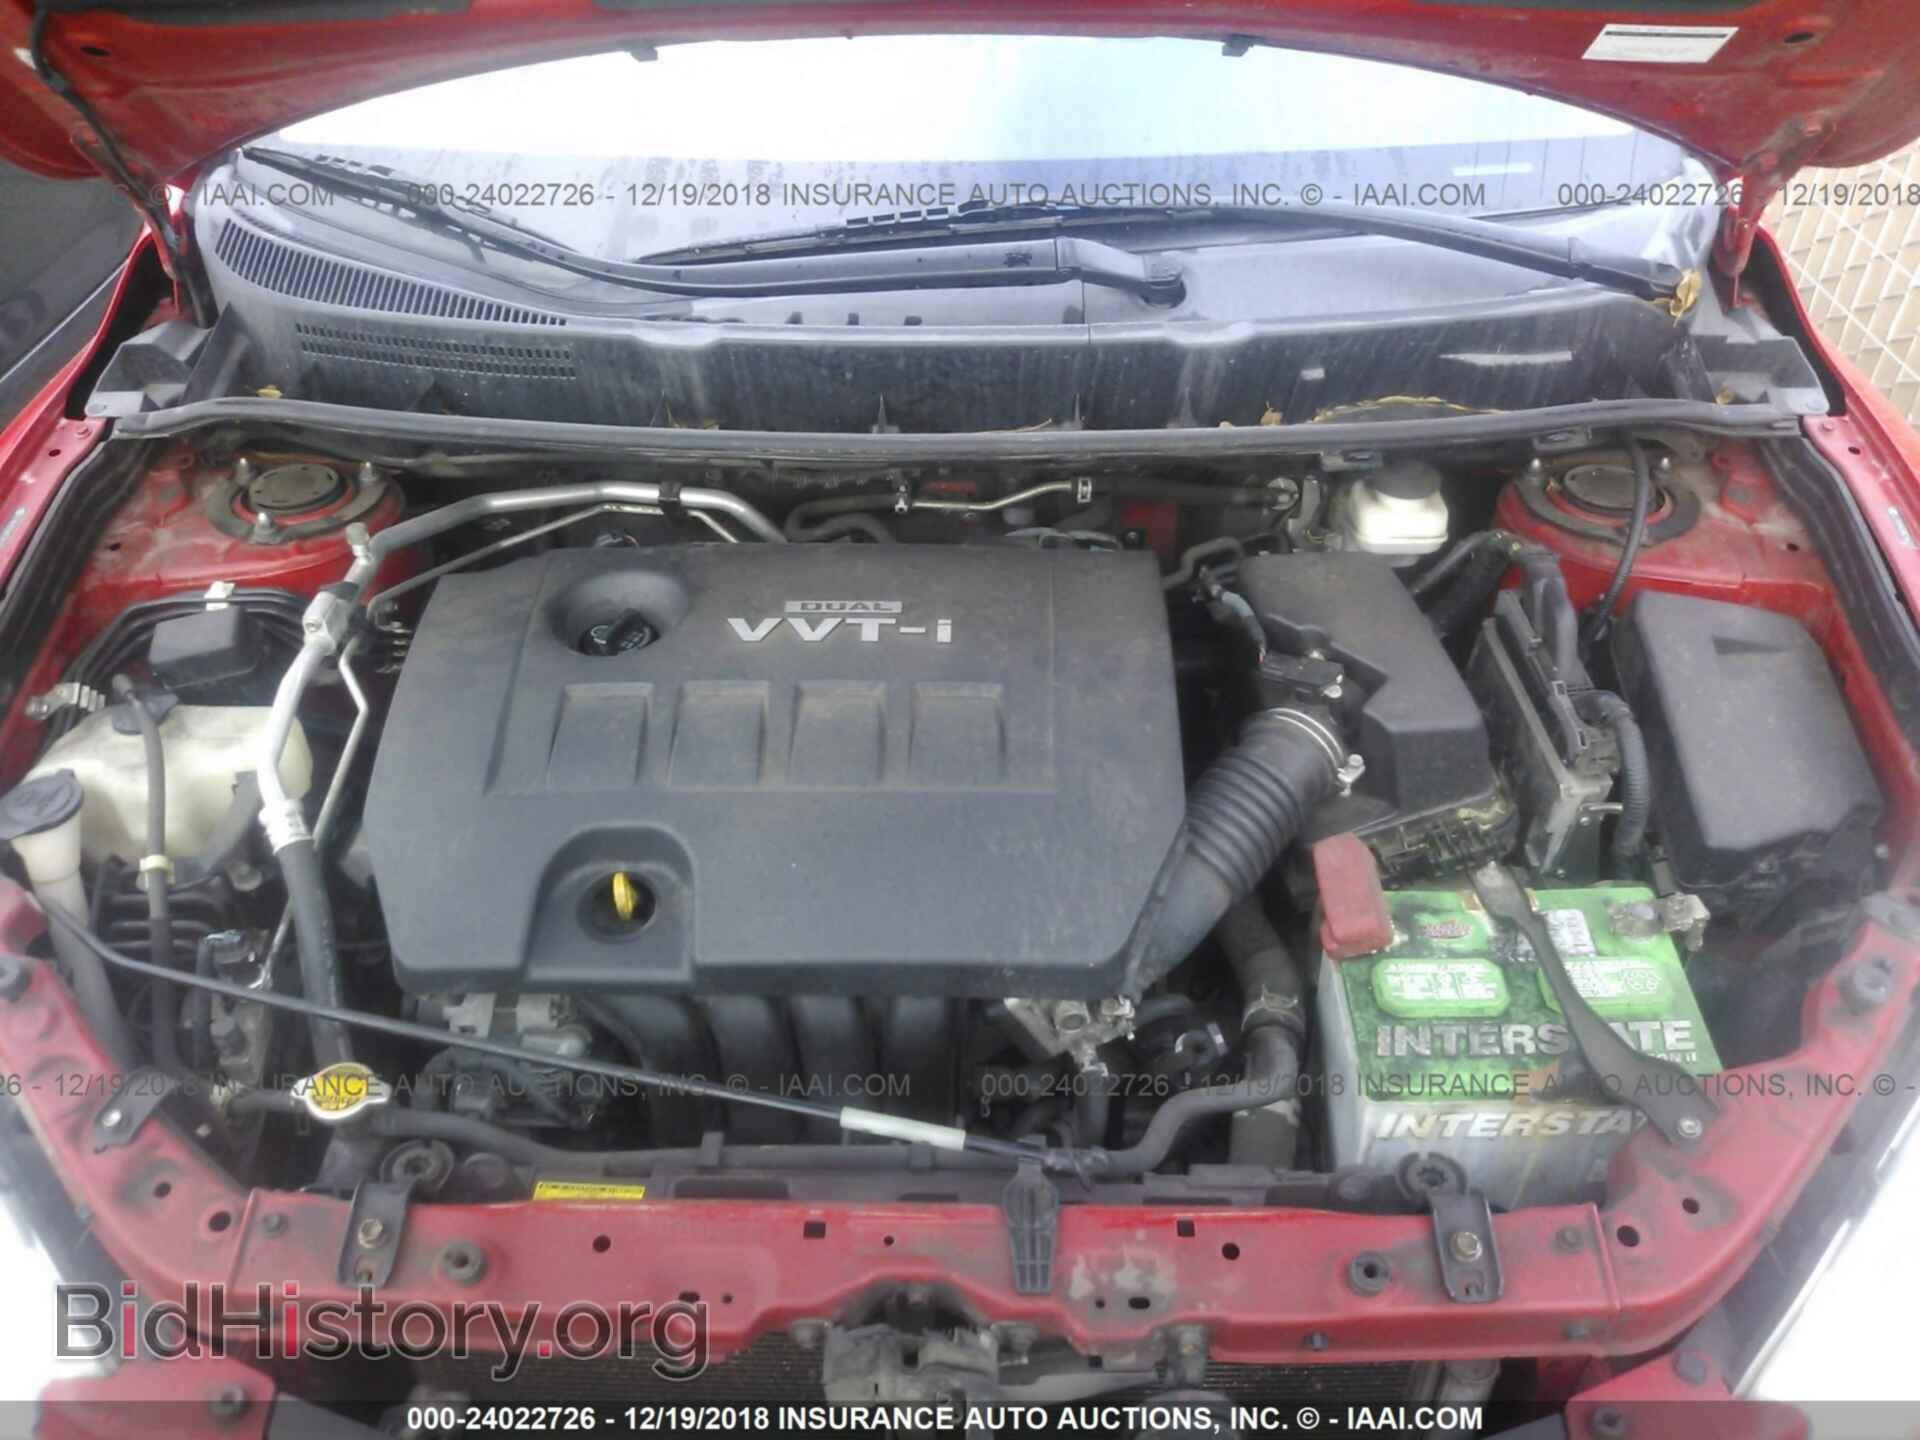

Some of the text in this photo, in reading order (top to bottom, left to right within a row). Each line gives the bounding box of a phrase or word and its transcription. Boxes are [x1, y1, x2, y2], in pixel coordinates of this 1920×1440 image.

[800, 602, 893, 611] DUAL
[727, 617, 952, 643] VVT-i
[1376, 1019, 1697, 1057] INTERSTE
